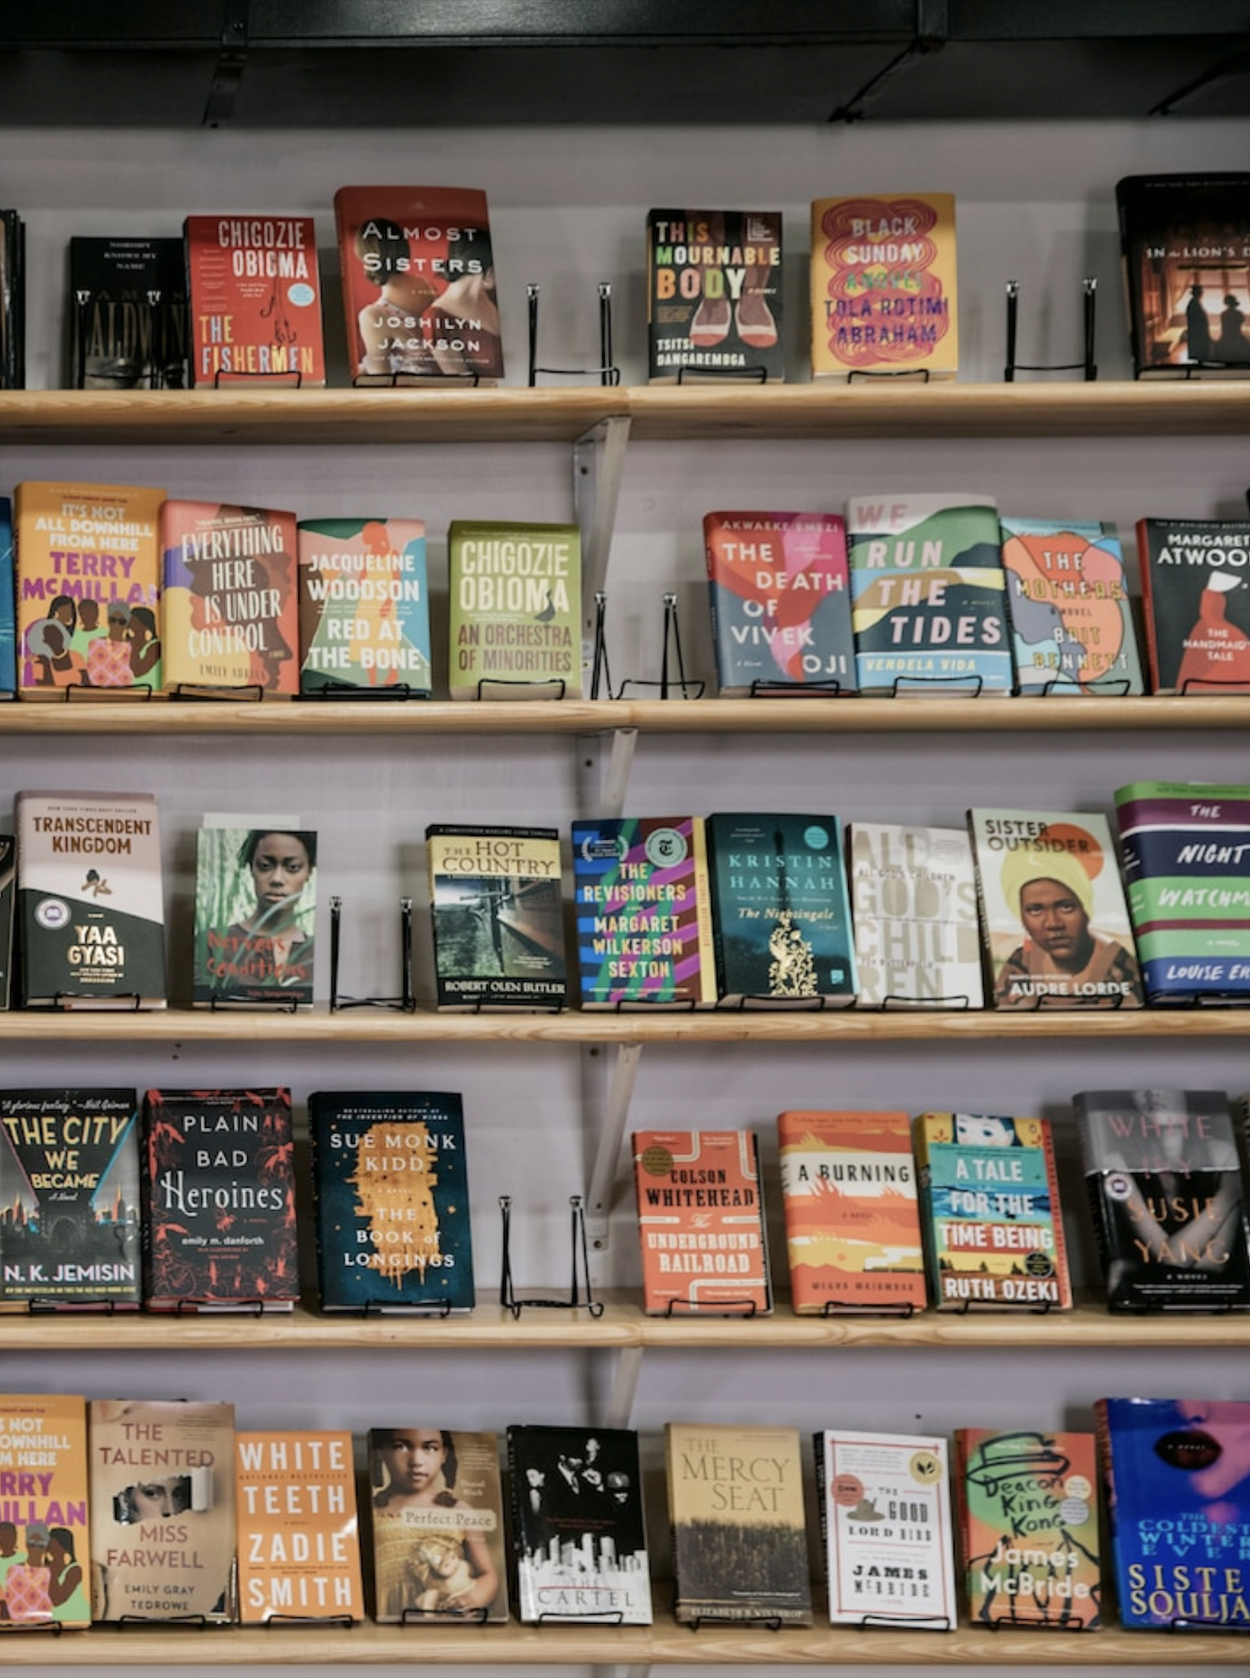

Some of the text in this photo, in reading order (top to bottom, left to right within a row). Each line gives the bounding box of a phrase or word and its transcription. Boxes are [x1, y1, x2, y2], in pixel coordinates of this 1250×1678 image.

[218, 220, 305, 249] CHIGOZIE
[363, 222, 477, 241] ALMOST
[656, 222, 708, 242] THIS
[852, 218, 916, 237] BLACK
[363, 252, 483, 274] SISTERS
[656, 246, 780, 266] MOURNABLE
[847, 244, 923, 265] SUNDAY
[657, 268, 747, 299] BODY
[199, 315, 233, 343] THE
[372, 316, 482, 330] JOSHILYN
[378, 338, 480, 351] JACKSON
[202, 346, 313, 374] FISHERMEN
[657, 353, 746, 366] DANGAREMBGA
[722, 520, 839, 532] AKWAEKE EMEZI
[856, 502, 908, 530] WE
[181, 525, 284, 562] EVERYTHING
[721, 542, 774, 562] THE
[308, 554, 415, 572] JACQUELINE
[461, 541, 569, 576] CHIGOZIE
[866, 540, 944, 568] RUN
[1043, 551, 1086, 570] THE
[212, 559, 256, 591] HERE
[756, 571, 843, 591] DEATH
[306, 580, 420, 601] WOODSON
[459, 576, 570, 613] OBIOMA
[878, 579, 949, 606] THE
[1015, 580, 1122, 600] MOTHERS
[203, 589, 283, 624] IS UNDER
[742, 599, 778, 617] OF
[327, 618, 406, 640] RED AT
[458, 624, 573, 648] AN ORCHESTRA
[730, 626, 816, 646] VIVEK
[890, 616, 1002, 644] TIDES
[1053, 626, 1101, 646] BRIT
[188, 622, 269, 658] CONTROL
[309, 647, 421, 670] THE BONE
[458, 650, 572, 672] OF MINORITIES
[802, 654, 846, 674] OJI
[866, 659, 976, 671] VENDELA VIDA
[1033, 653, 1128, 670] BENNETT
[1190, 804, 1221, 818] THE
[32, 816, 152, 835] TRANSCENDENT
[984, 819, 1049, 836] SISTER
[52, 836, 131, 854] KINGDOM
[443, 841, 525, 857] THE HOT
[987, 836, 1090, 854] OUTSIDER
[1177, 844, 1250, 864] NIGHT
[442, 858, 555, 875] COUNTRY
[619, 863, 648, 879] THE
[728, 854, 832, 868] KRISTIN
[584, 884, 686, 902] REVISIONERS
[730, 876, 835, 890] HANNAH
[74, 925, 118, 944] YAA
[594, 916, 680, 933] MARGARET
[68, 946, 125, 966] GYASI
[592, 938, 684, 956] WILKERSON
[608, 960, 670, 978] SEXTON
[445, 981, 566, 994] ROBERT OLEN BUTLER
[1009, 982, 1131, 996] AUDRE LORDE
[3, 1116, 128, 1144] THE CITY
[184, 1116, 259, 1132] PLAIN
[1111, 1116, 1213, 1140] WHITE
[330, 1133, 456, 1150] SUE MONK
[45, 1150, 79, 1170] WE
[197, 1150, 248, 1167] BAD
[366, 1157, 424, 1172] KIDD
[1142, 1157, 1193, 1180] IVY
[670, 1170, 726, 1184] COLSON
[798, 1164, 910, 1182] A BURNING
[956, 1159, 1023, 1182] A TALE
[30, 1174, 100, 1188] BECAME
[160, 1170, 284, 1217] Heroines
[646, 1189, 755, 1207] WHITEHEAD
[950, 1191, 1034, 1215] FOR THE
[376, 1208, 417, 1220] THE
[1127, 1196, 1216, 1222] SUSIE
[182, 1237, 207, 1246] emily
[223, 1236, 265, 1245] danforth
[356, 1230, 441, 1245] BOOK of
[648, 1233, 758, 1248] UNDERGROUND
[937, 1224, 1053, 1249] TIME BEING
[344, 1252, 455, 1267] LONGINGS
[1134, 1239, 1229, 1264] YANG
[658, 1253, 750, 1272] RAILROAD
[4, 1264, 136, 1282] N. K. JEMISIN
[945, 1278, 1058, 1301] RUTH OZEKI
[122, 1424, 163, 1440] THE
[17, 1451, 57, 1466] HERE
[100, 1447, 214, 1467] TALENTED
[238, 1441, 345, 1470] WHITE
[681, 1452, 790, 1483] MERCY
[982, 1476, 1064, 1498] Deacon
[243, 1486, 345, 1514] TEETH
[712, 1484, 785, 1512] SEAT
[140, 1525, 188, 1542] MISS
[248, 1533, 348, 1562] ZADIE
[990, 1541, 1079, 1568] James
[107, 1549, 204, 1568] FARWELL
[852, 1565, 929, 1580] JAMES
[125, 1584, 195, 1595] EMILY GRAY
[248, 1577, 352, 1607] SMITH
[980, 1572, 1090, 1598] McBride
[130, 1600, 189, 1610] TEDROWE
